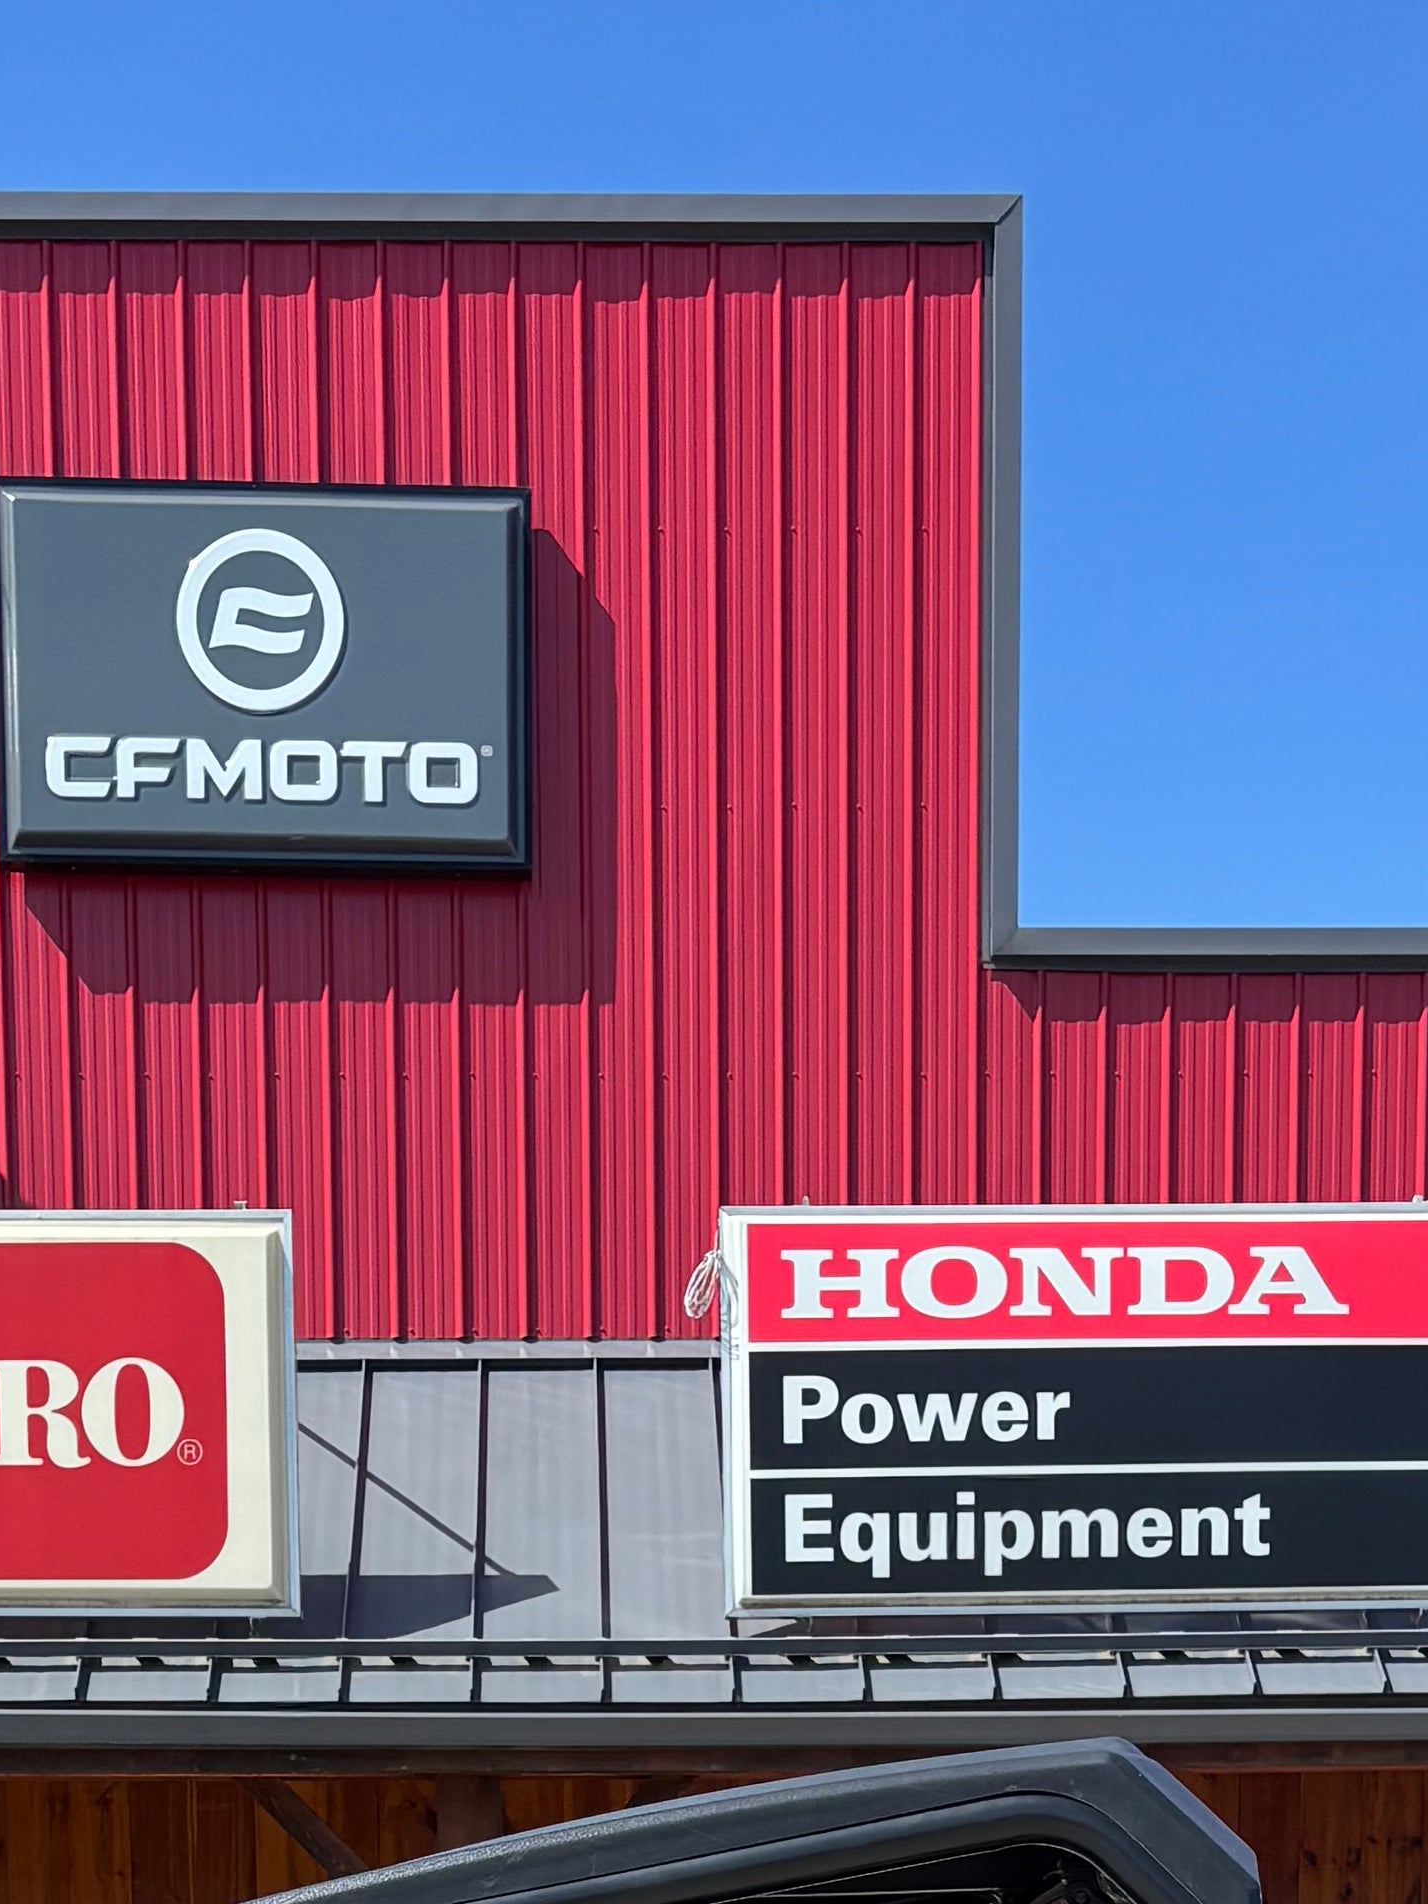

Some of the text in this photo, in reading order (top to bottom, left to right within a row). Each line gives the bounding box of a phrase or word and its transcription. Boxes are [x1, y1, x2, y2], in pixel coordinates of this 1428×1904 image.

[45, 735, 480, 804] CFMOTO
[780, 1245, 1350, 1319] HONDA
[782, 1374, 1071, 1445] Power
[783, 1491, 1271, 1578] Equipment
